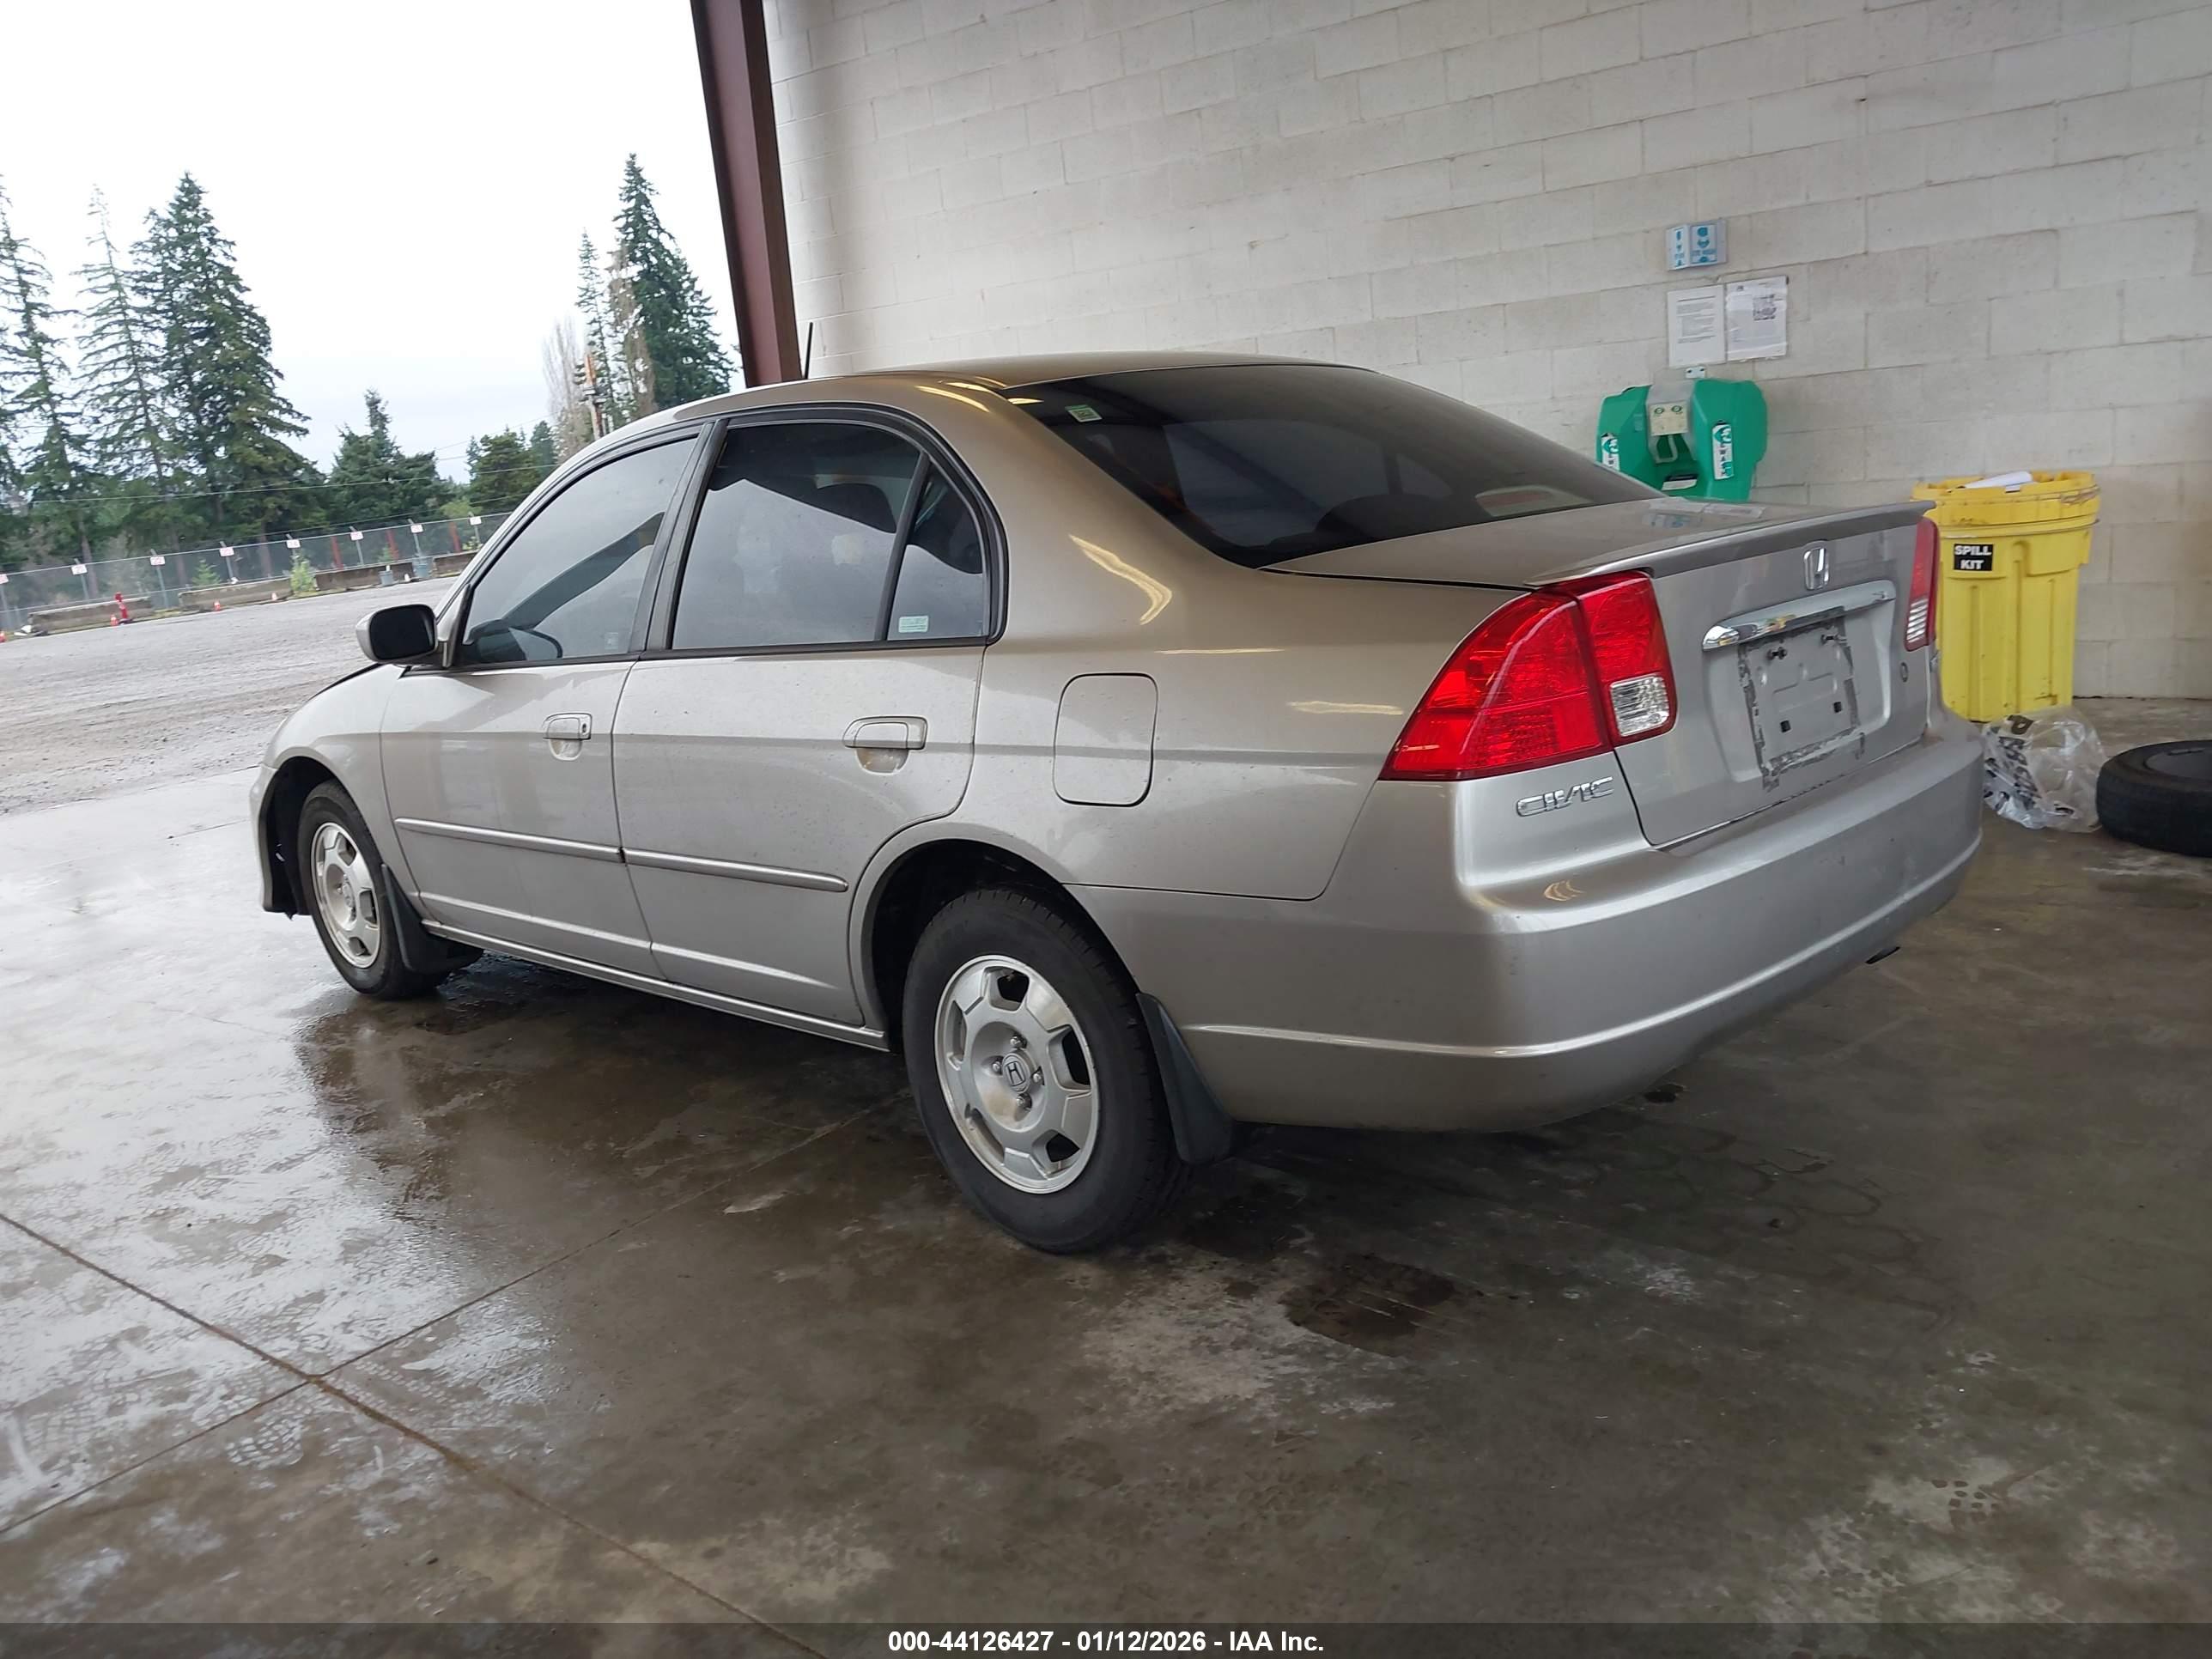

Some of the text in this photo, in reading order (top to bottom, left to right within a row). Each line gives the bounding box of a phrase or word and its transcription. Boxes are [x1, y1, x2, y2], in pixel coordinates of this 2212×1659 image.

[1954, 544, 1992, 556] SPILL
[1960, 559, 1984, 570] KIT
[1516, 775, 1614, 817] CIVIC
